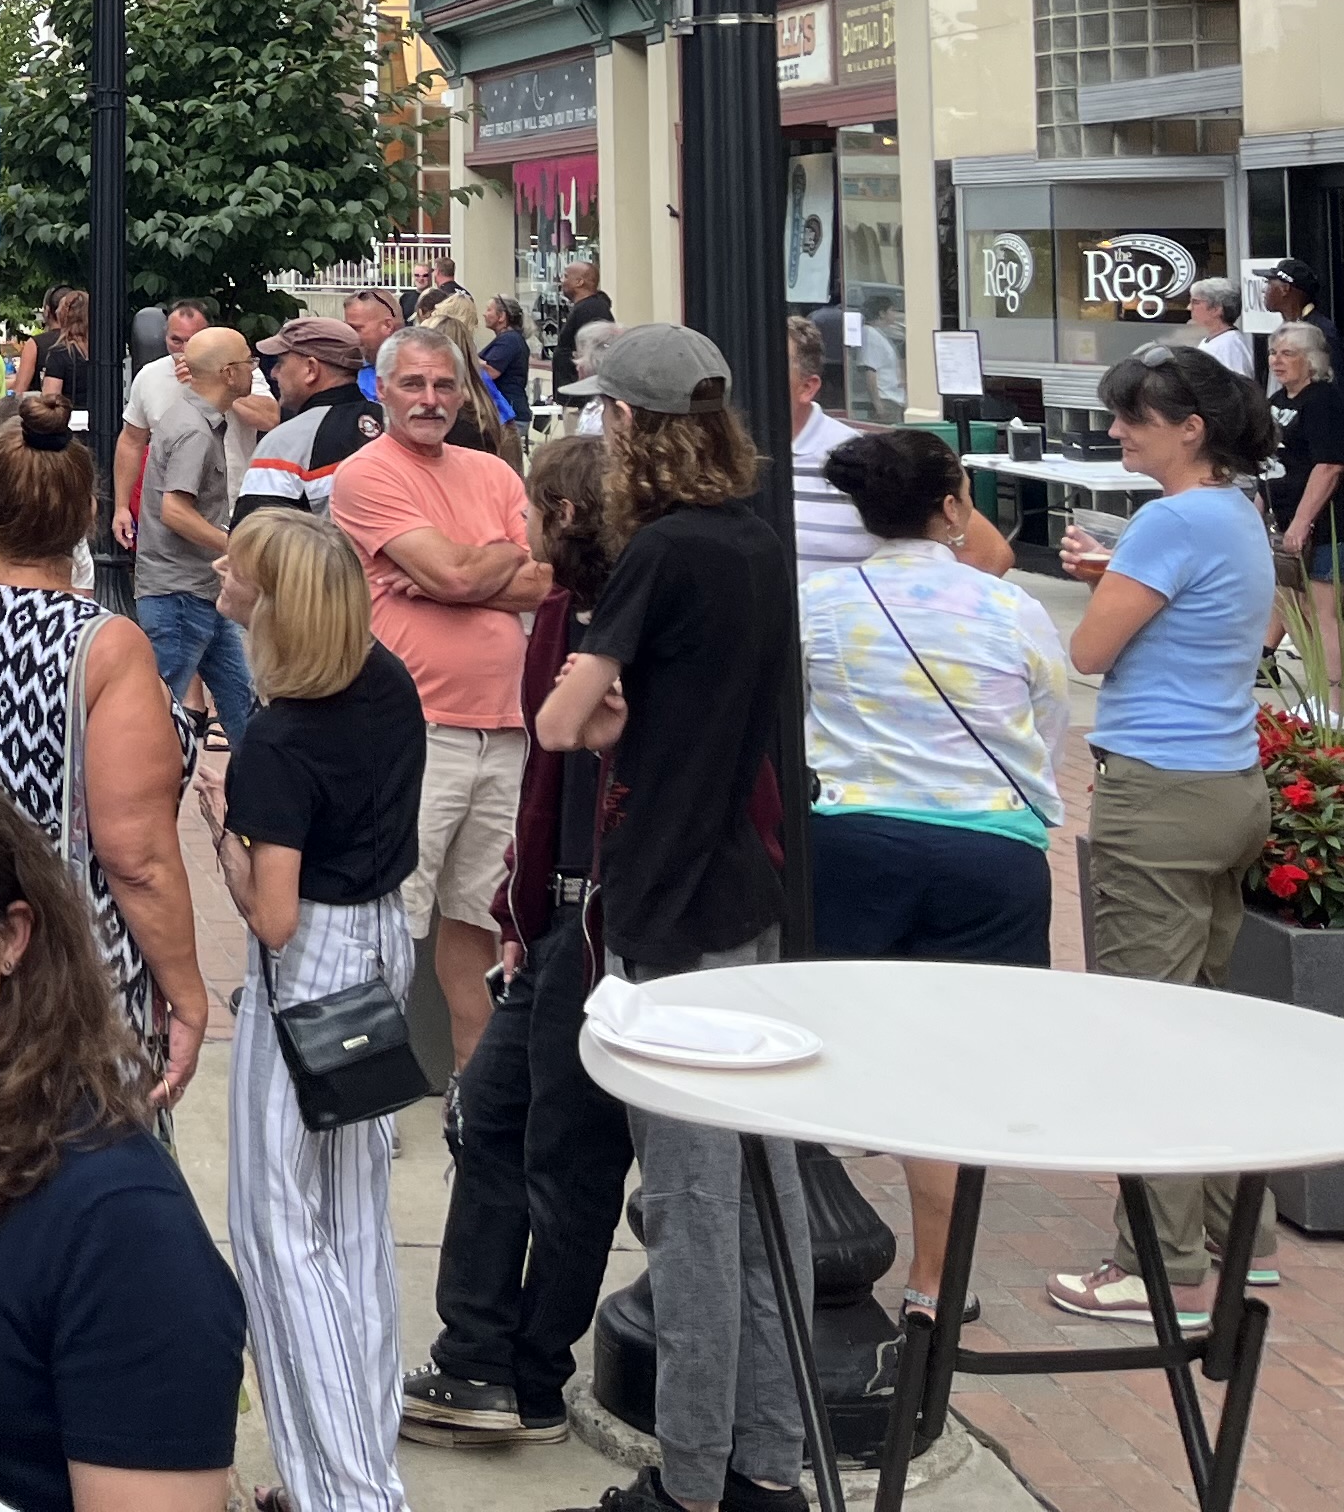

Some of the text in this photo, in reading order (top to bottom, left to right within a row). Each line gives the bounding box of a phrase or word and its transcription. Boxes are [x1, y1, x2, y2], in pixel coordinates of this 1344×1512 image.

[982, 248, 1020, 313] Reg
[1082, 250, 1164, 319] Reg
[1114, 247, 1133, 262] the
